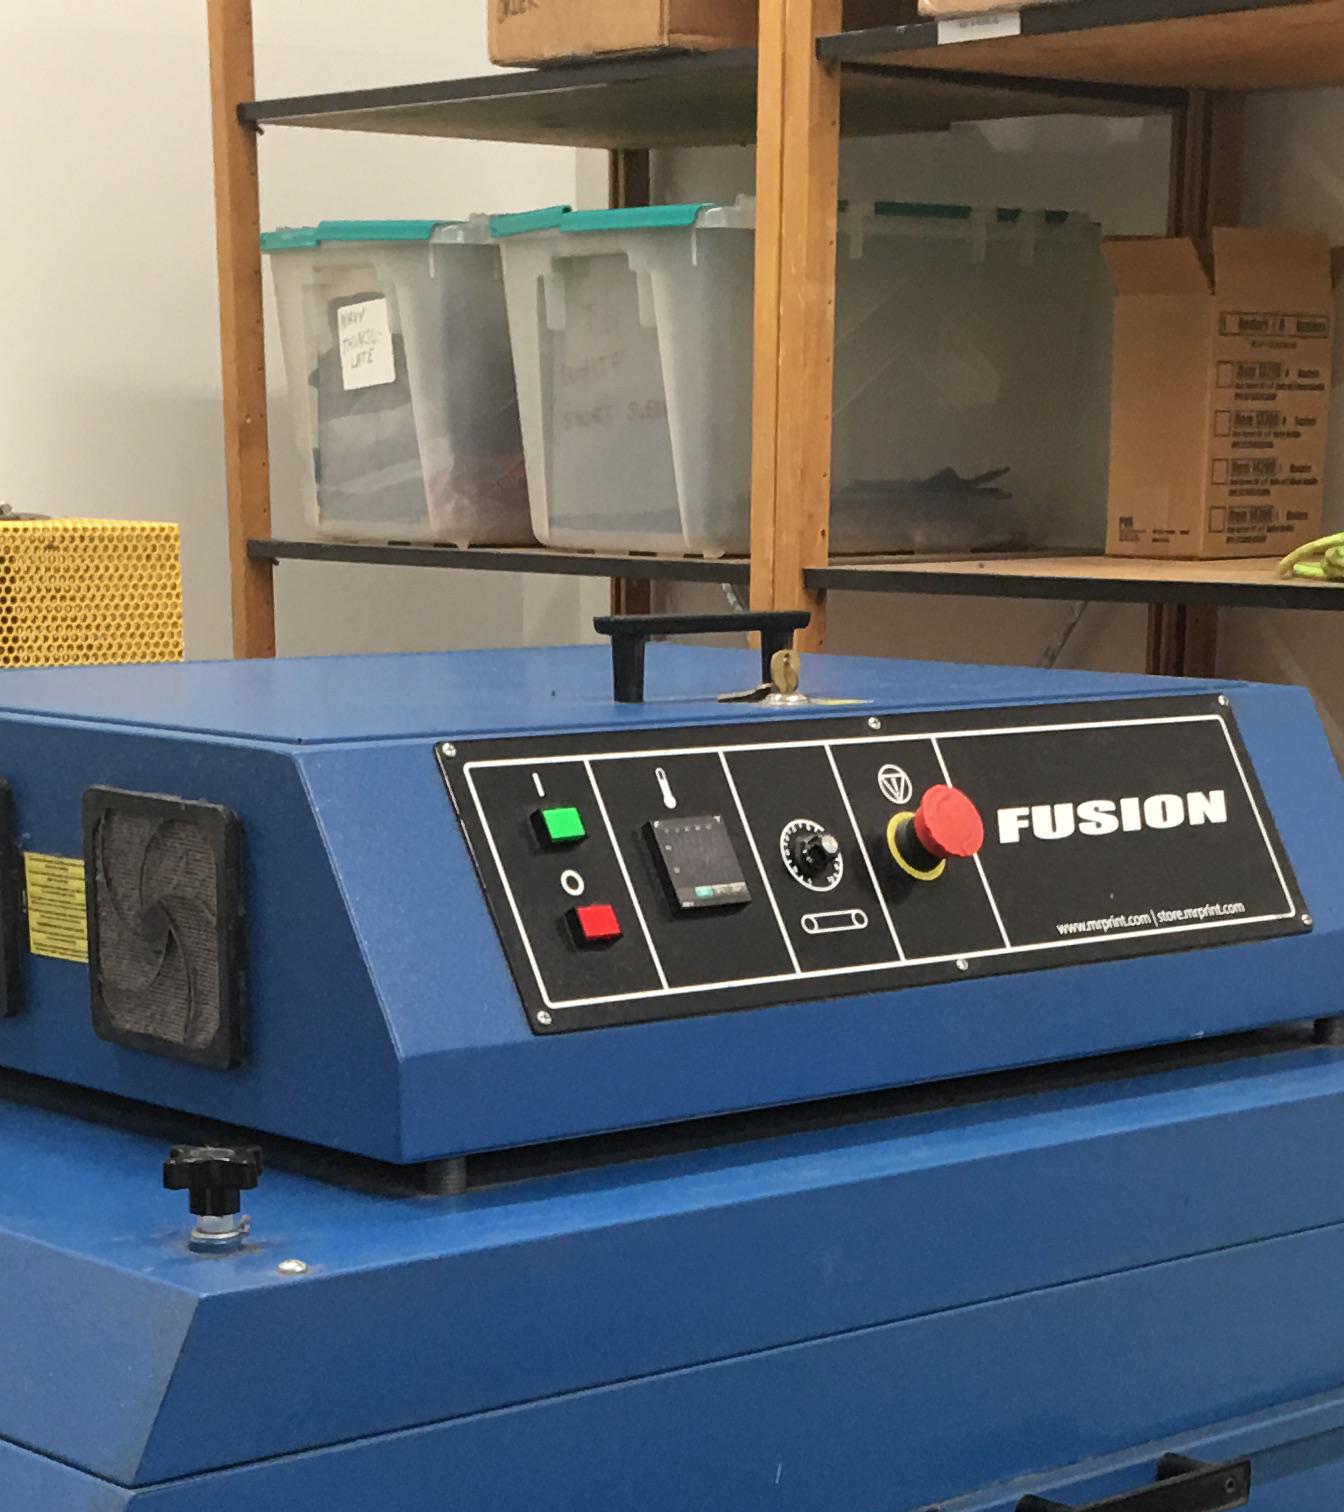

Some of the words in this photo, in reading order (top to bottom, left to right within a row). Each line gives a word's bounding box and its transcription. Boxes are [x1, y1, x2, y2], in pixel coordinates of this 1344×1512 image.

[997, 790, 1227, 844] FUSION
[1056, 912, 1152, 935] www.mrprint.com
[1157, 902, 1246, 922] store.mrprint.com
